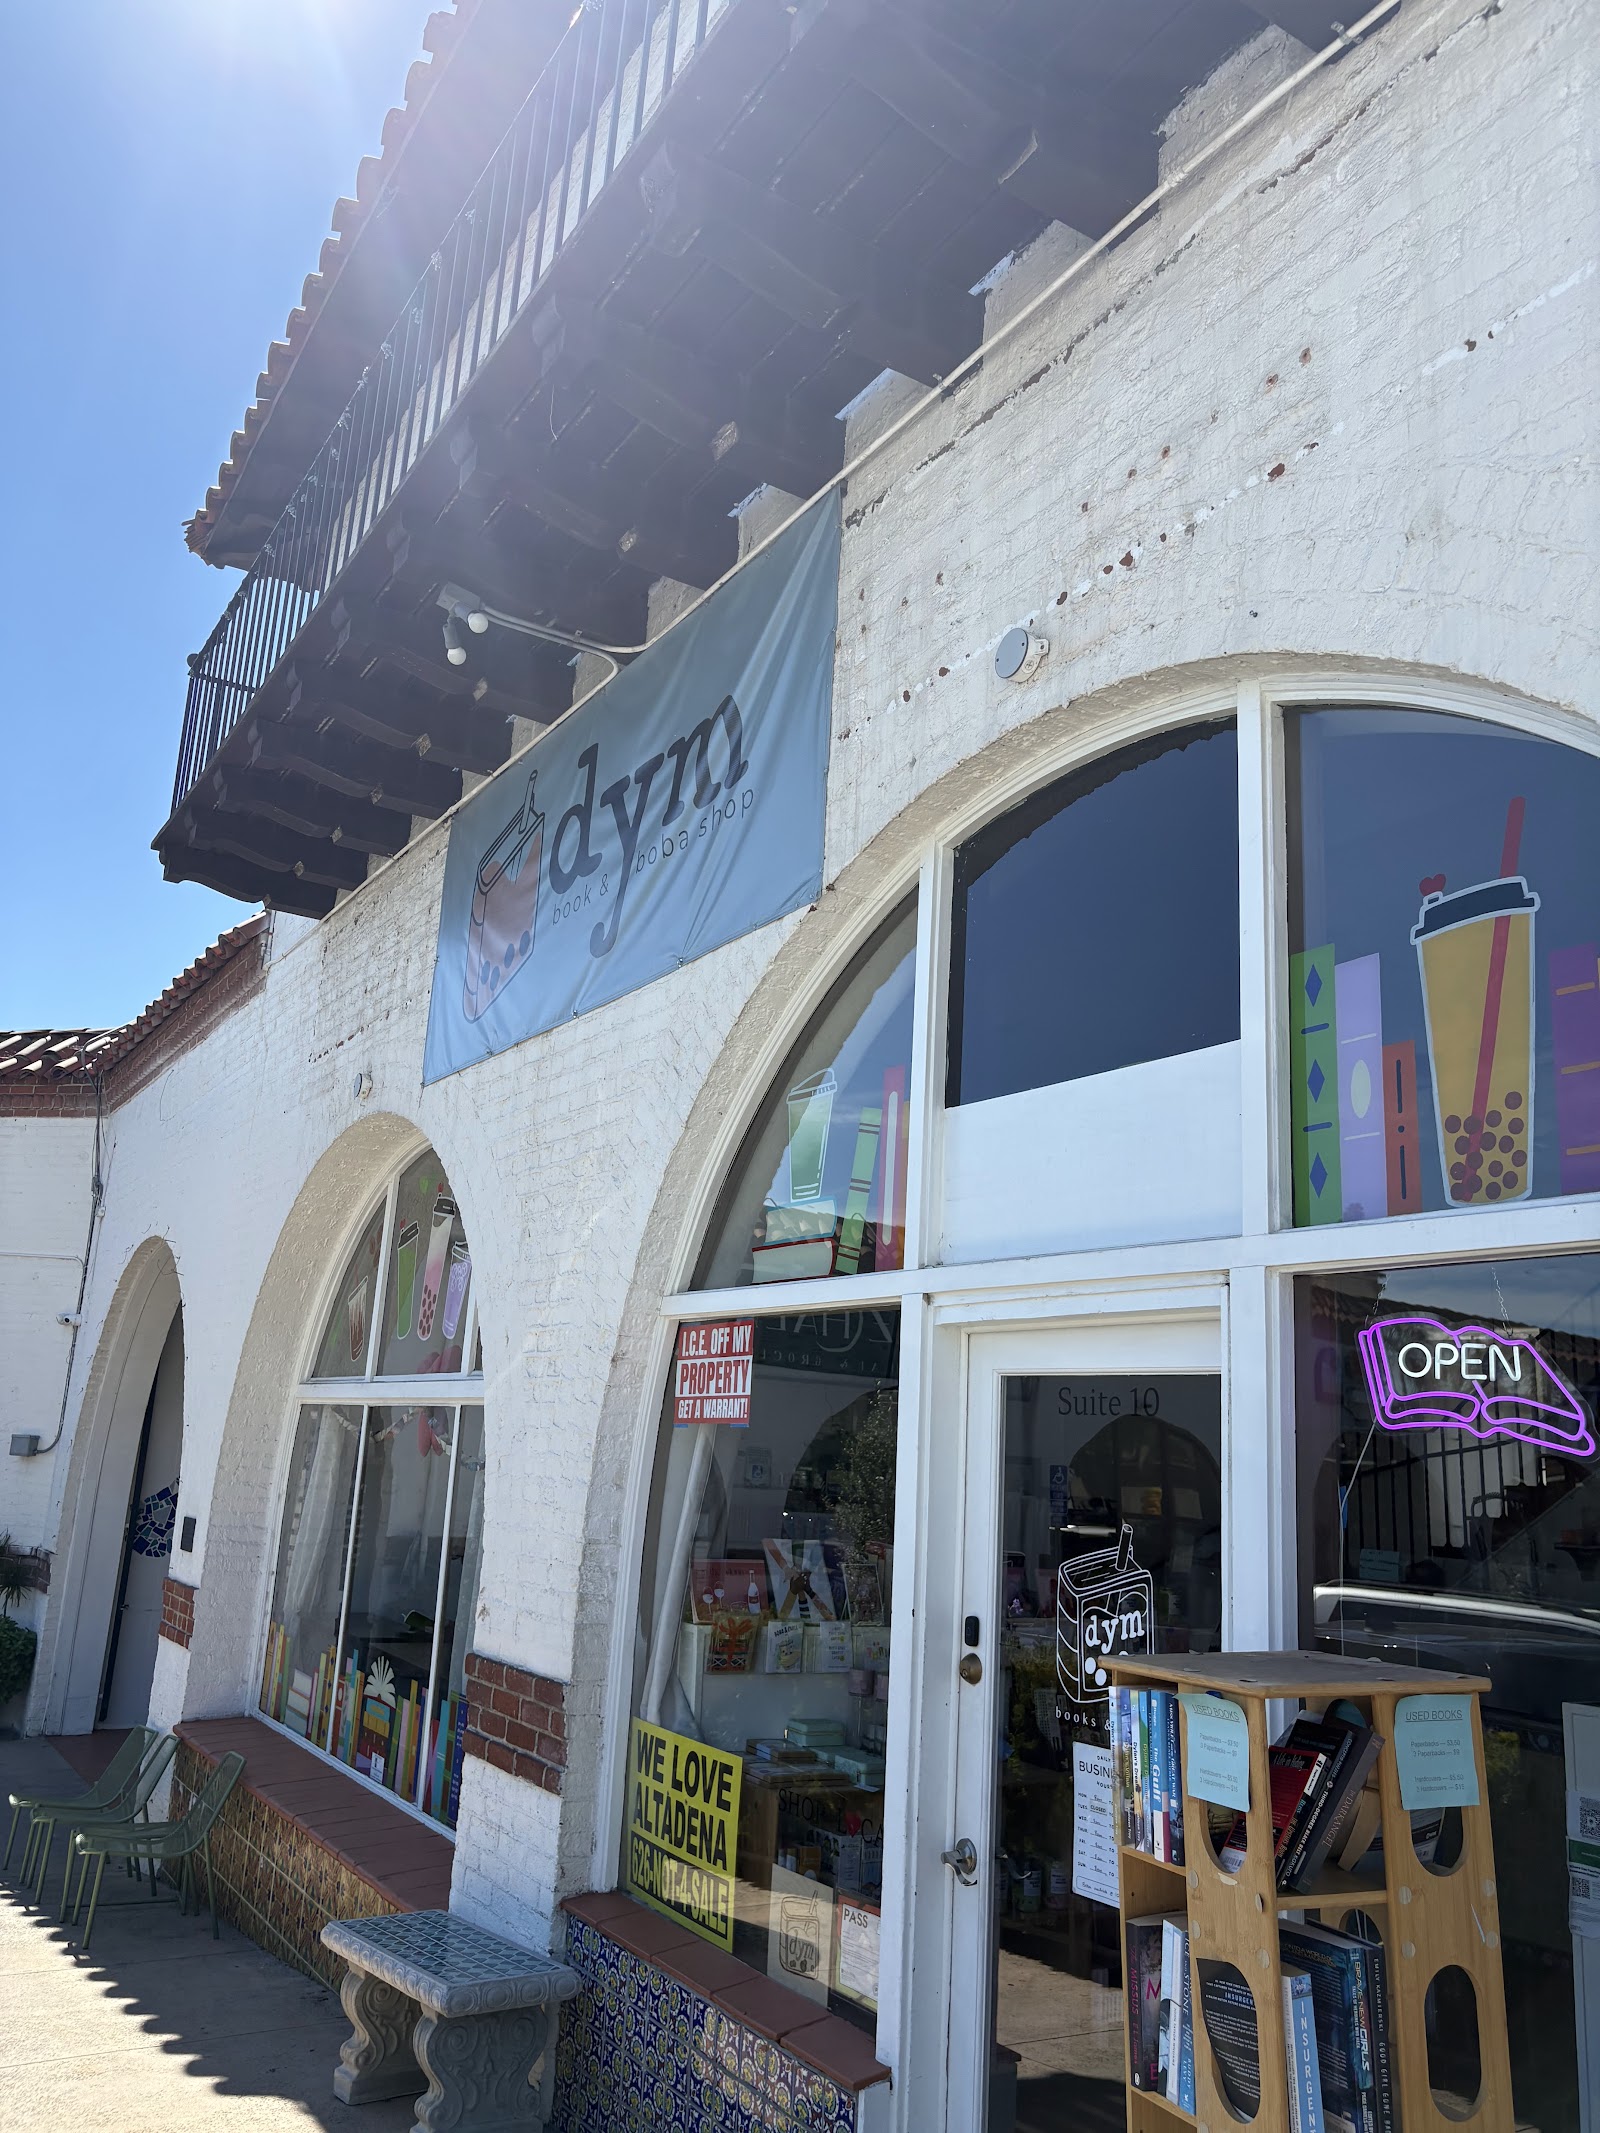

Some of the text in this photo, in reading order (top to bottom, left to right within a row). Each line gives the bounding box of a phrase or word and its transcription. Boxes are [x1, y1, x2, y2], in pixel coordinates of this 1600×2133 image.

[549, 695, 750, 958] dym
[553, 787, 755, 925] book & boba shop
[681, 1329, 708, 1357] I.C.E.
[710, 1327, 730, 1355] OFF
[732, 1324, 752, 1353] MY
[679, 1359, 750, 1395] PROPERTY
[1397, 1341, 1522, 1382] OPEN
[677, 1397, 749, 1419] GET A WARRANT!
[1058, 1386, 1160, 1417] Suite 10
[1084, 1608, 1146, 1655] dym
[1055, 1706, 1097, 1727] books
[1191, 1703, 1240, 1721] USED BOOKS
[1405, 1709, 1463, 1721] USED BOOKS
[1410, 1740, 1439, 1748] Paperbacks
[1417, 1749, 1446, 1758] Paperbacks
[637, 1729, 734, 1813] WE LOVE
[1153, 1763, 1161, 1802] Gulf
[633, 1781, 728, 1871] ALTADENA
[1321, 1796, 1353, 1848] DARKANGEL
[843, 1907, 868, 1929] PASS
[789, 1929, 814, 1961] dym
[1131, 1968, 1139, 2015] MISSUS
[1182, 1973, 1190, 2016] STONE
[1354, 1961, 1364, 2000] BRAVE
[1375, 1984, 1384, 2032] KAZMIERSKI
[1378, 2042, 1387, 2064] GOOD
[1380, 2068, 1389, 2087] GIRL
[1382, 2092, 1391, 2115] GONE
